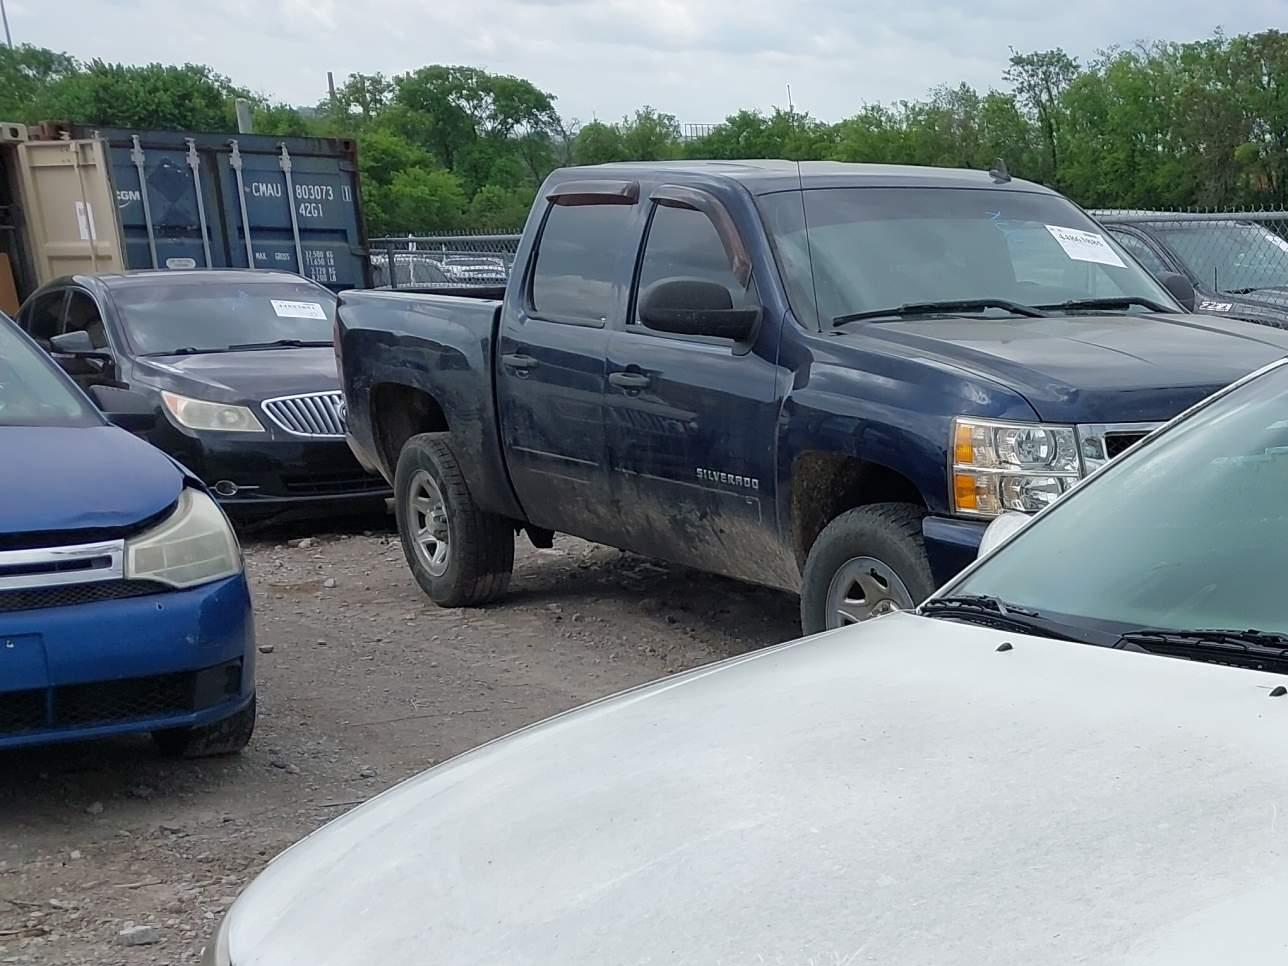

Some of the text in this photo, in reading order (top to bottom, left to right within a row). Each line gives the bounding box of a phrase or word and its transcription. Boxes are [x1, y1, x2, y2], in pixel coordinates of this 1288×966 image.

[252, 182, 281, 197] CMAU
[295, 184, 334, 201] 803073
[299, 203, 323, 217] 42G1
[696, 467, 760, 490] SILVERADO
